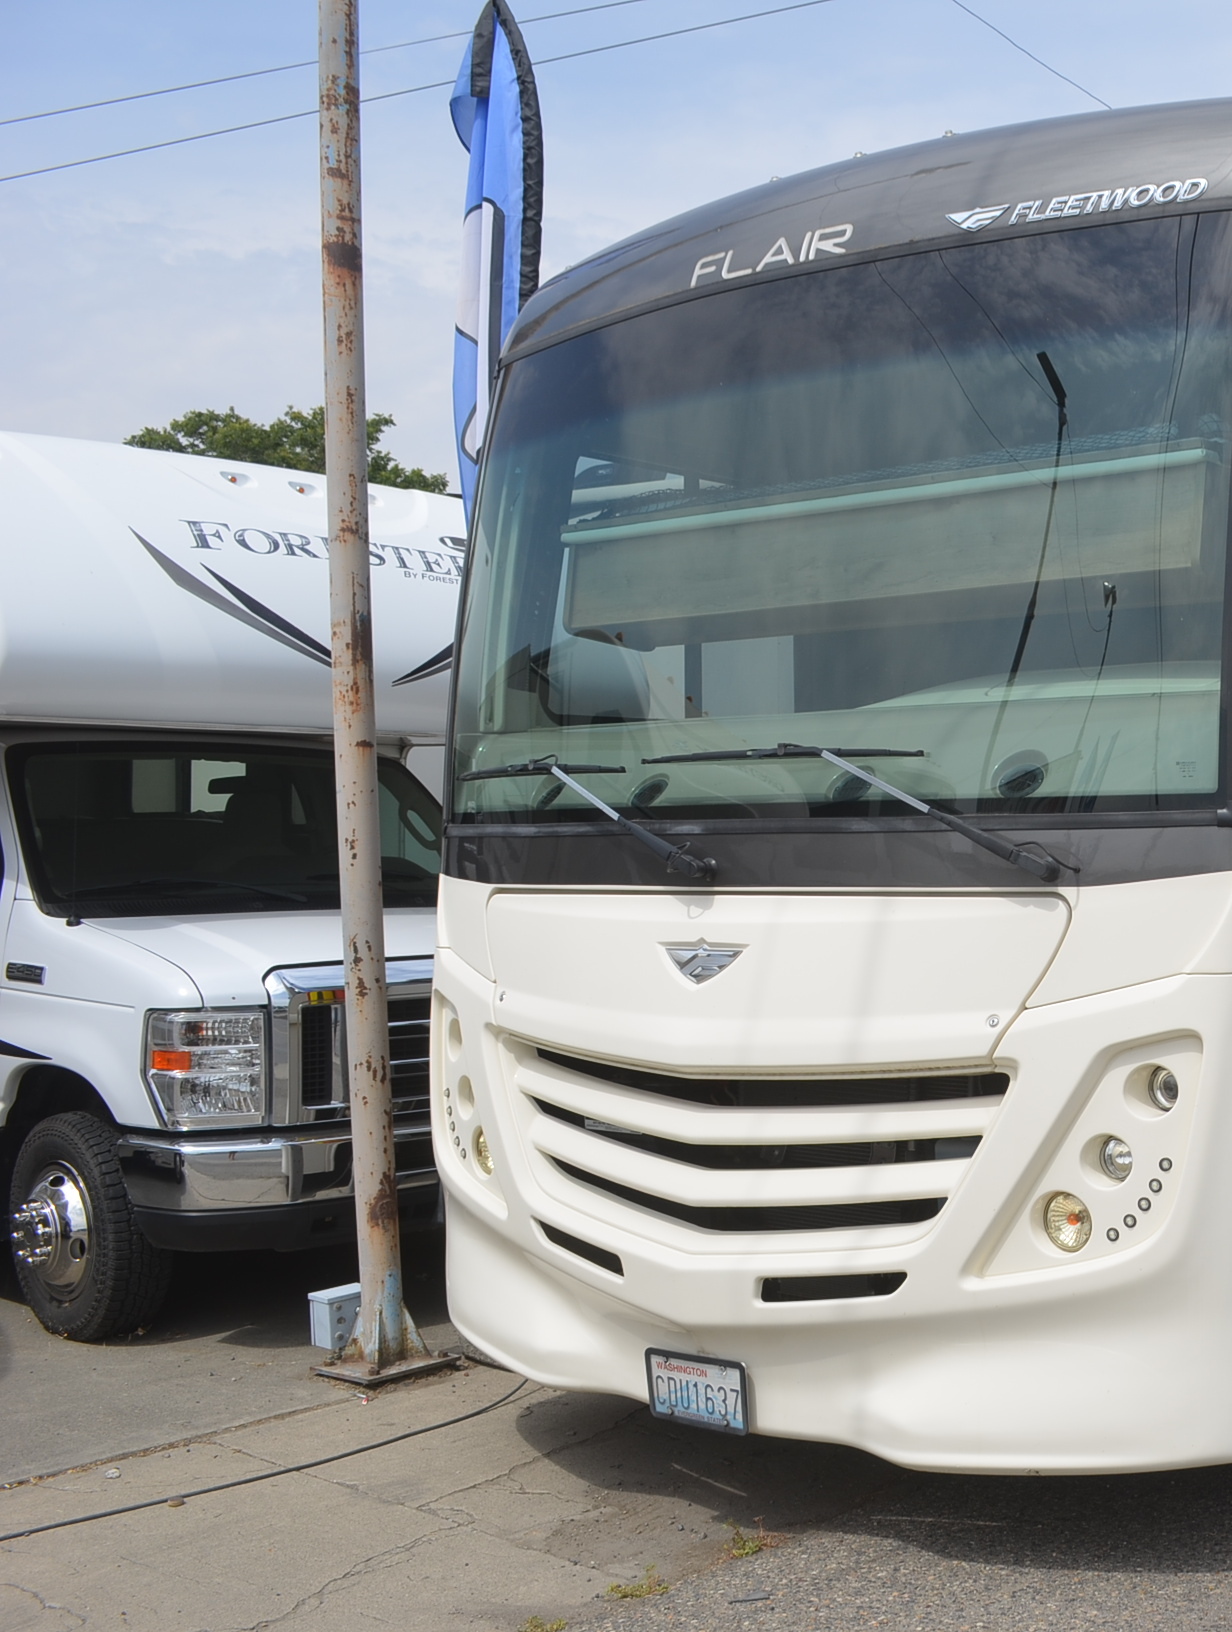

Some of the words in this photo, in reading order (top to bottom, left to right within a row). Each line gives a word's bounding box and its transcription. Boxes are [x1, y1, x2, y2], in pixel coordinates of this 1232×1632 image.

[1008, 177, 1209, 226] FLEETWOOD
[690, 223, 854, 289] FLAIR
[421, 573, 460, 585] FOREST
[655, 1361, 708, 1378] WASHINGTON
[655, 1374, 740, 1421] CDU1637
